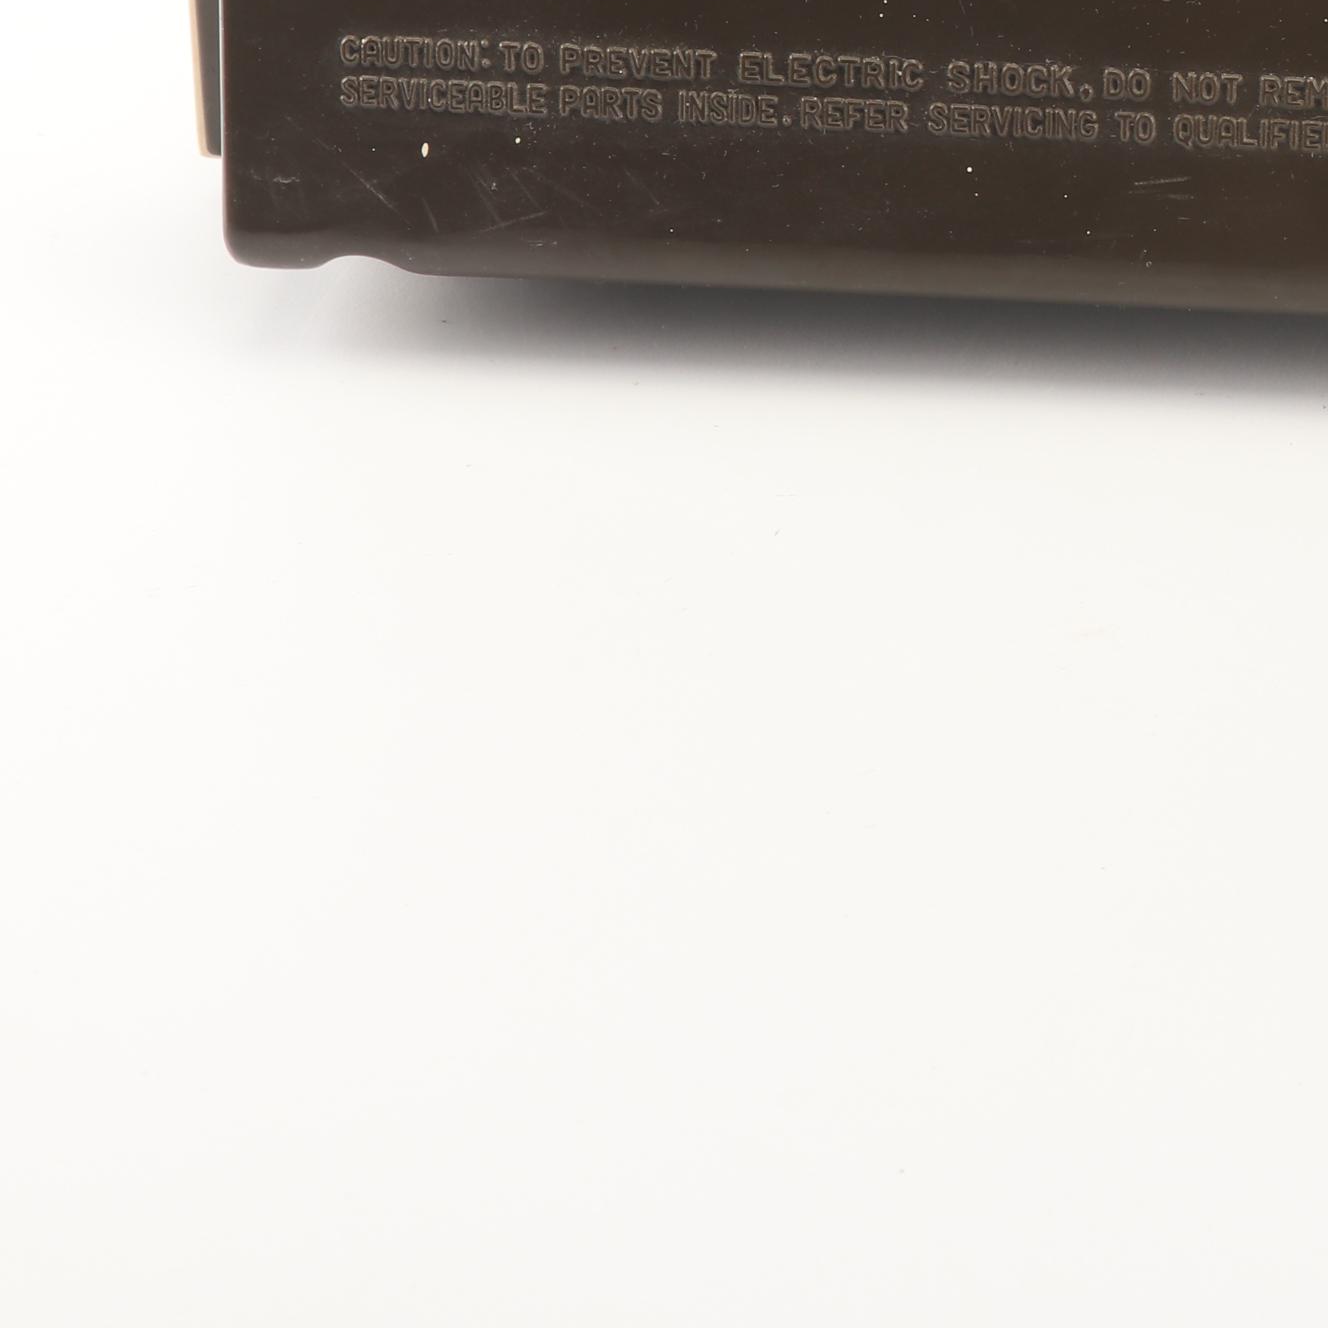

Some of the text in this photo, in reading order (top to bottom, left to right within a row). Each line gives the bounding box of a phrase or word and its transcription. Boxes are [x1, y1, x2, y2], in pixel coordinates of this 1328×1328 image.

[338, 34, 491, 69] CAUTION:
[499, 41, 545, 74] TO
[558, 42, 718, 81] PREVENT
[737, 50, 925, 93] ELECTRIC
[1102, 67, 1151, 100] DO
[1171, 71, 1244, 105] NOT
[338, 74, 549, 116] SERVICEABLE
[558, 84, 664, 122] PARTS
[677, 89, 793, 127] INSIDE.
[800, 95, 909, 133] REFER
[927, 101, 1100, 141] SERVICING
[1114, 111, 1157, 143] TO
